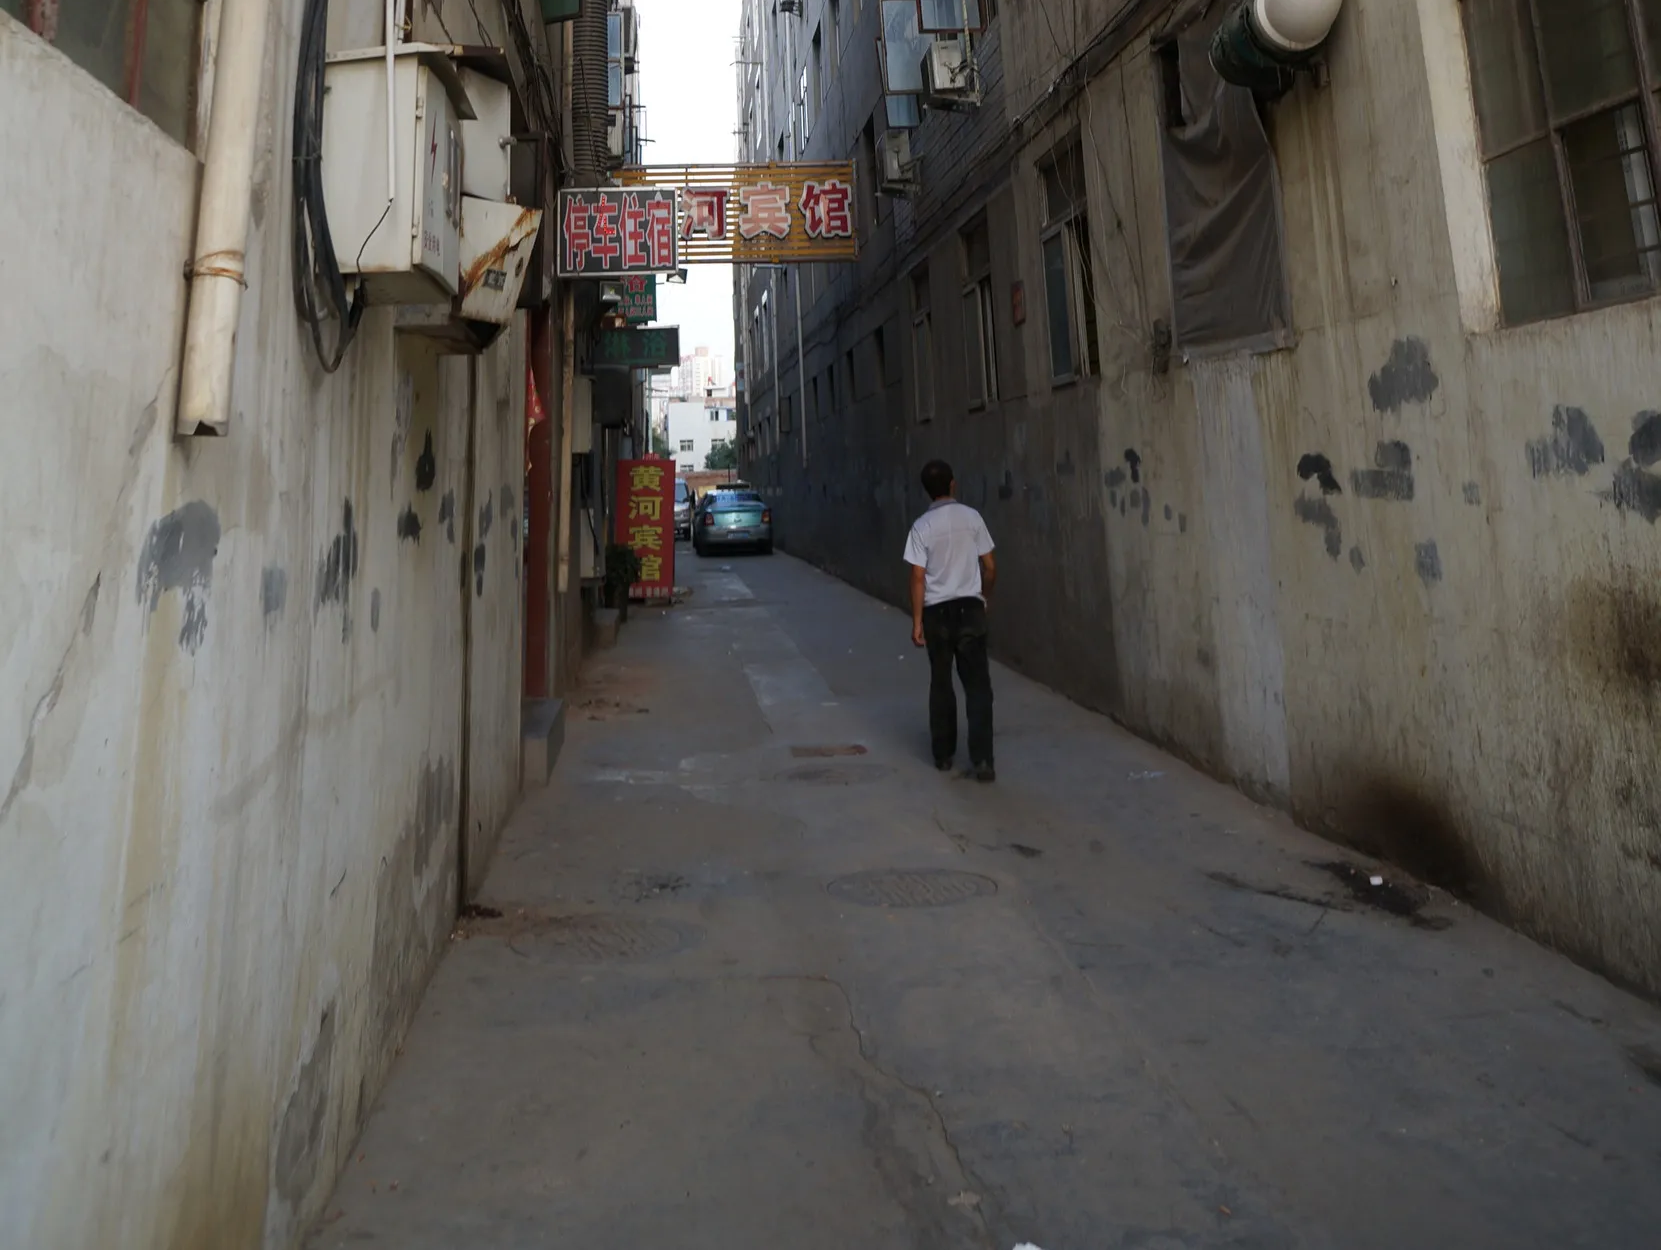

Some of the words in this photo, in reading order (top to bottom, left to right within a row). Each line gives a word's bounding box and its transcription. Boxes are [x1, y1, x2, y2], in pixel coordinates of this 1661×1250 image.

[564, 192, 672, 270] 停车住宿
[679, 179, 852, 239] 河宾馆
